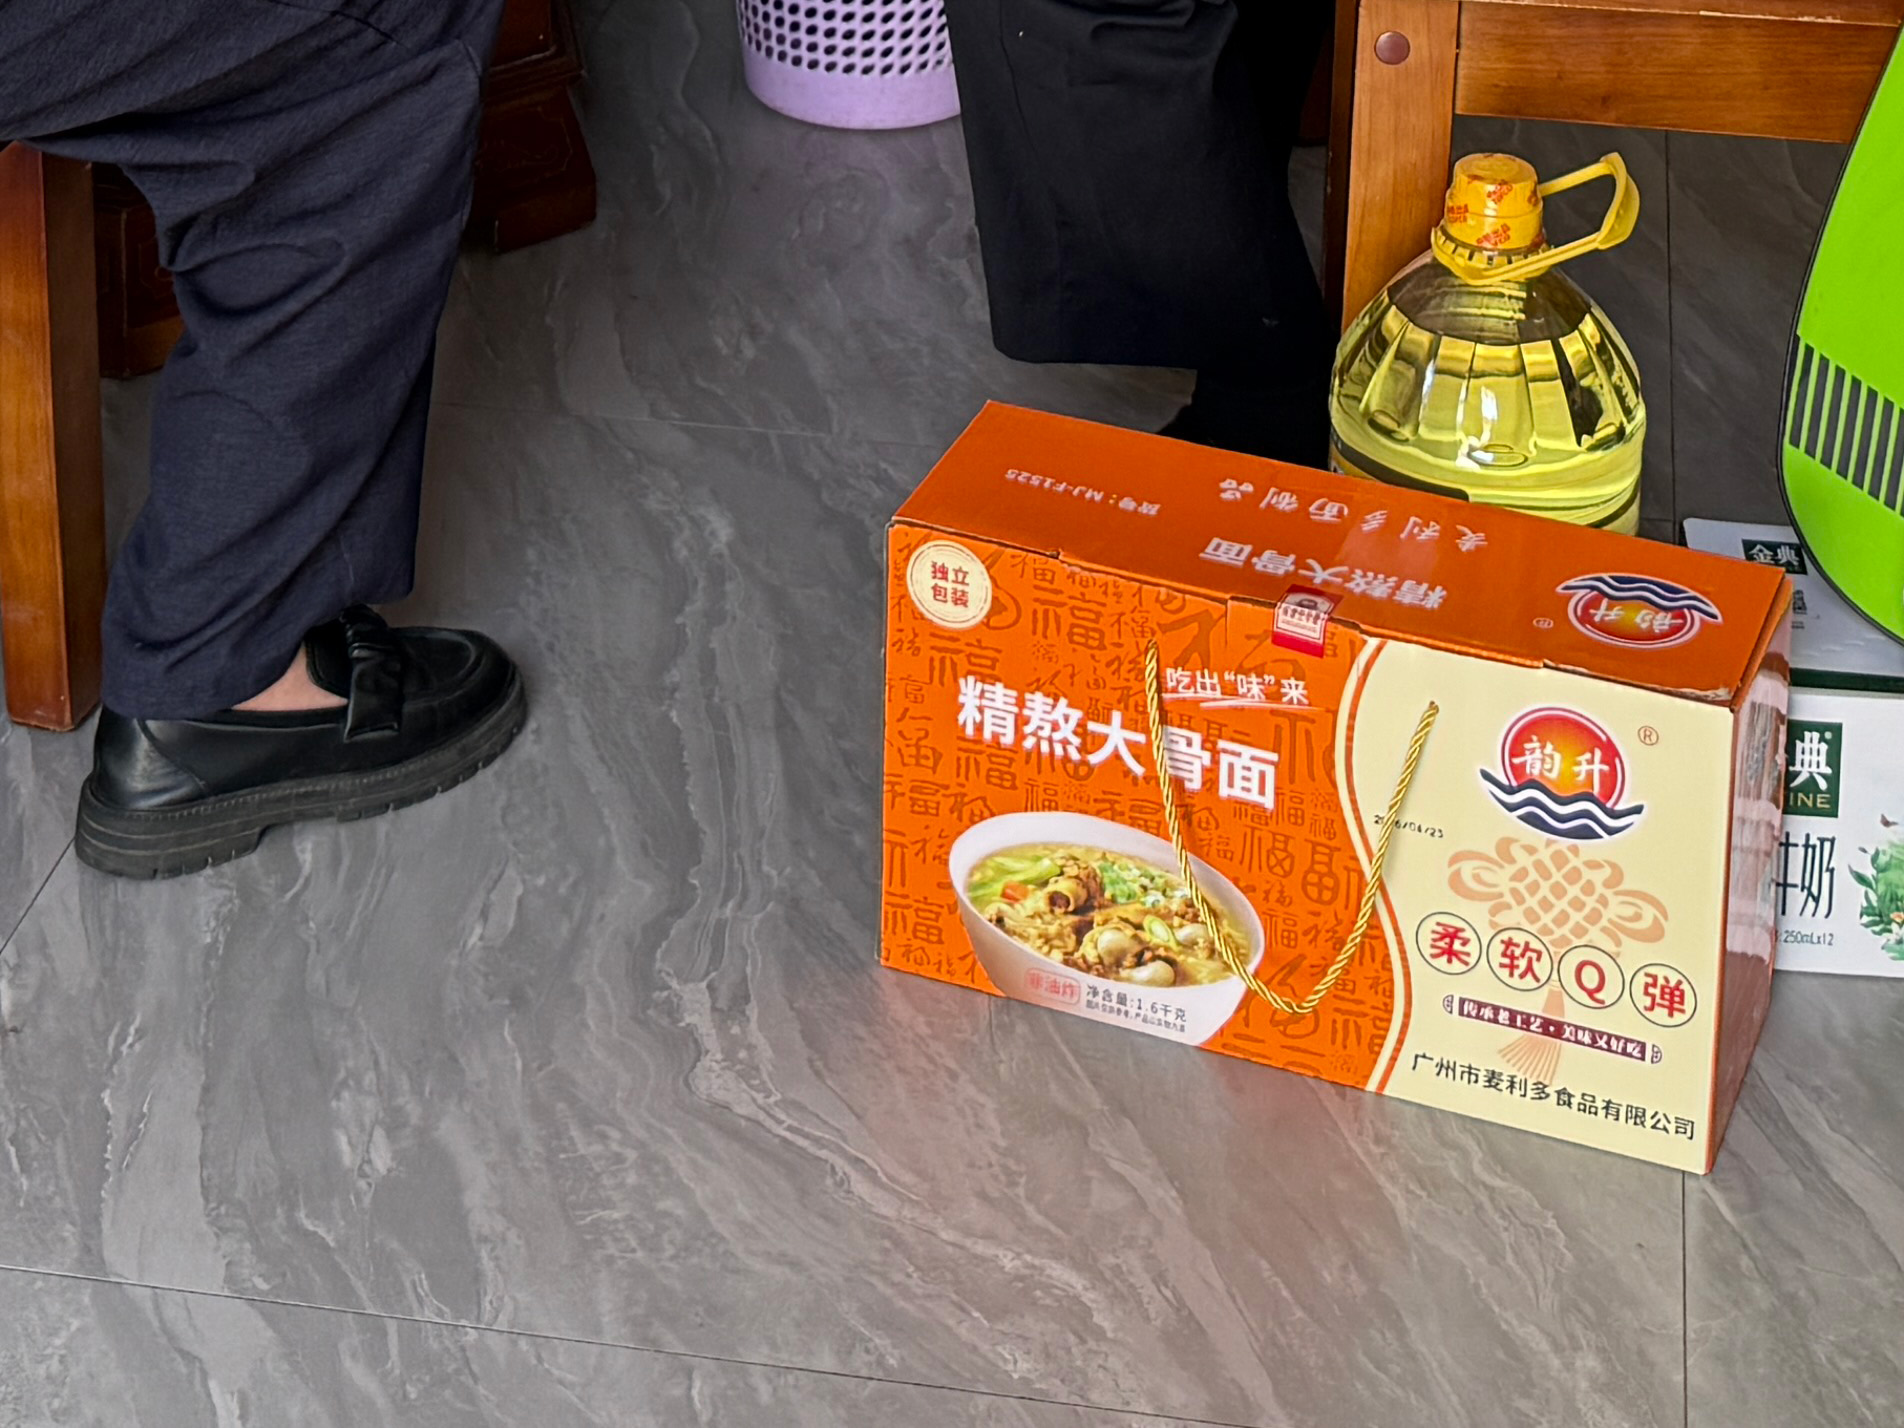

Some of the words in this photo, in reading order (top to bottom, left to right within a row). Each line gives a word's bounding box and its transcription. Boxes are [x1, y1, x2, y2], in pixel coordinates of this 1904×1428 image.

[931, 560, 970, 587] 独立
[1199, 537, 1447, 609] 精熬大骨面
[1749, 544, 1800, 565] 金典
[931, 583, 970, 608] 包装
[1589, 598, 1684, 633] 韵升
[957, 675, 1280, 811] 精熬大骨面
[1511, 734, 1610, 795] 韵升
[1027, 973, 1076, 999] 非油炸
[1430, 921, 1687, 1019] 柔软Q弹
[1412, 1052, 1696, 1140] 广州市麦利多食品有限公司
